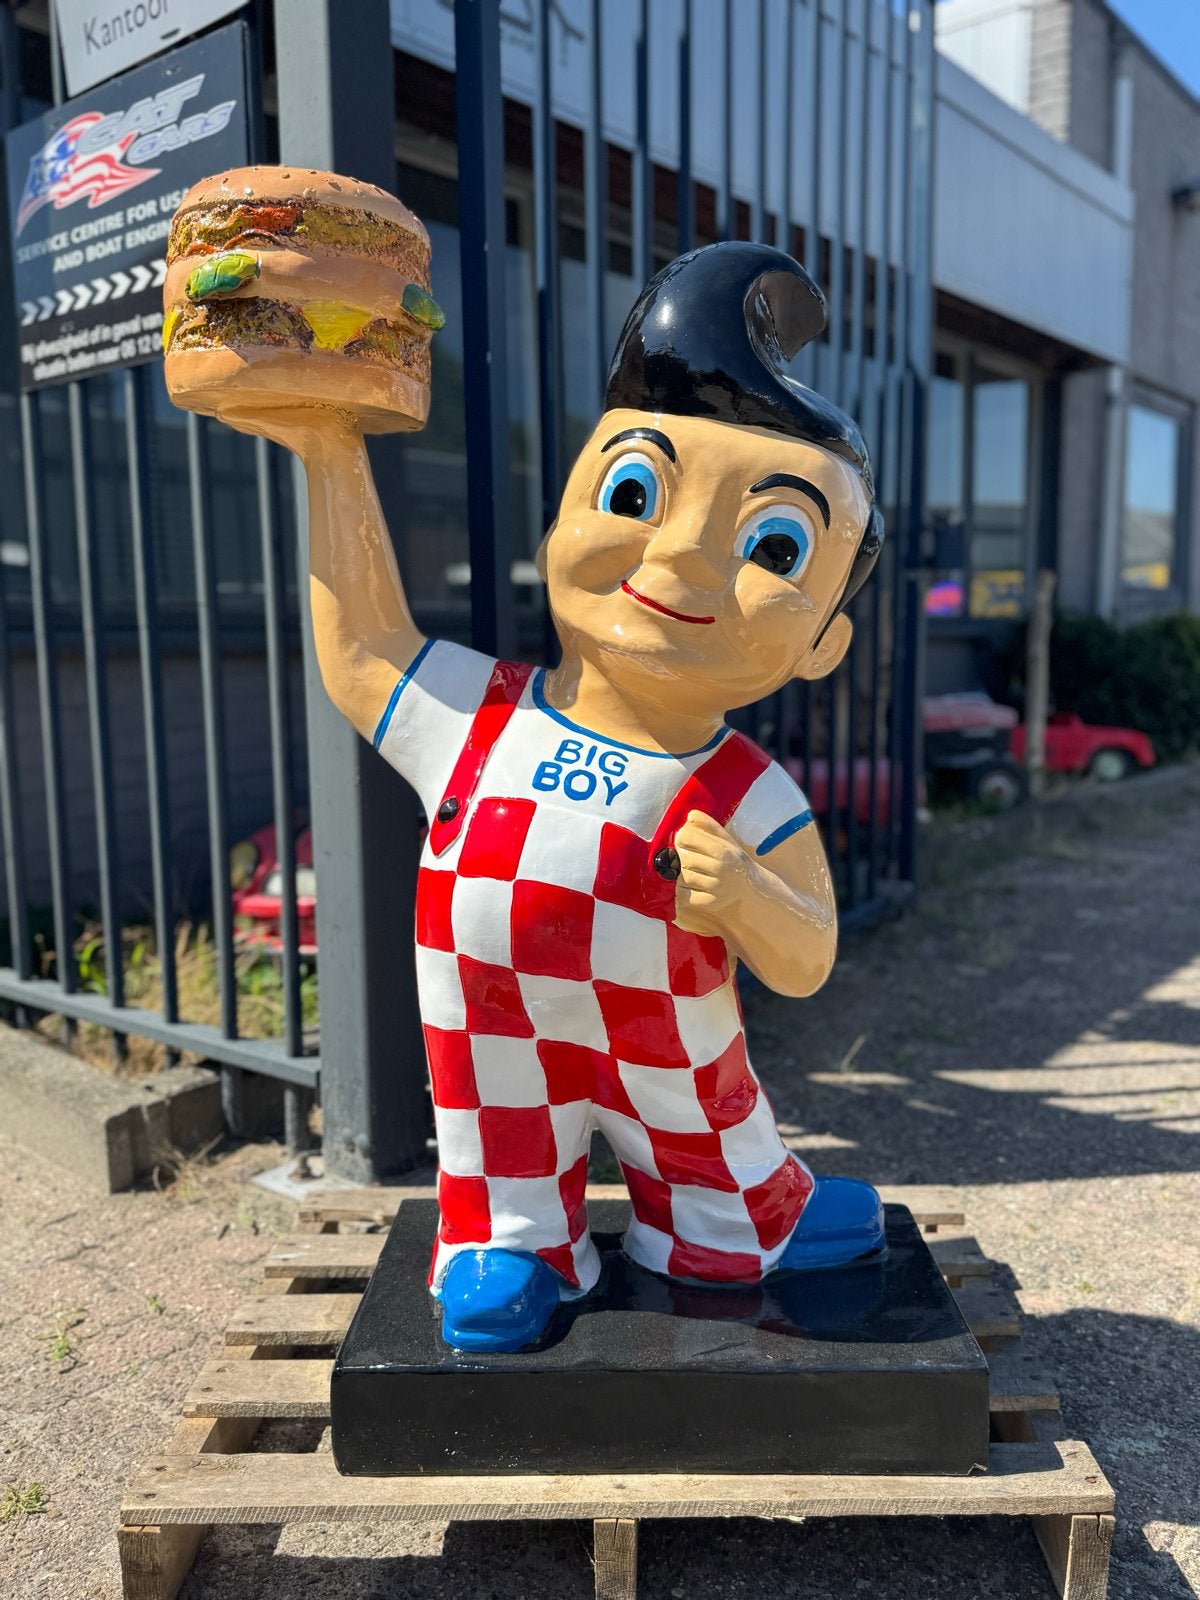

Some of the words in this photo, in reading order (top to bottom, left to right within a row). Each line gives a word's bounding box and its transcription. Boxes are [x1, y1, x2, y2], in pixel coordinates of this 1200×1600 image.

[17, 231, 69, 264] SERVICE
[71, 211, 125, 244] CENTRE
[127, 201, 157, 225] FOR
[159, 187, 190, 212] US
[53, 253, 84, 273] AND
[85, 235, 123, 263] BOAT
[125, 218, 171, 249] ENGIN
[554, 739, 629, 777] BIG
[532, 761, 629, 806] BOY
